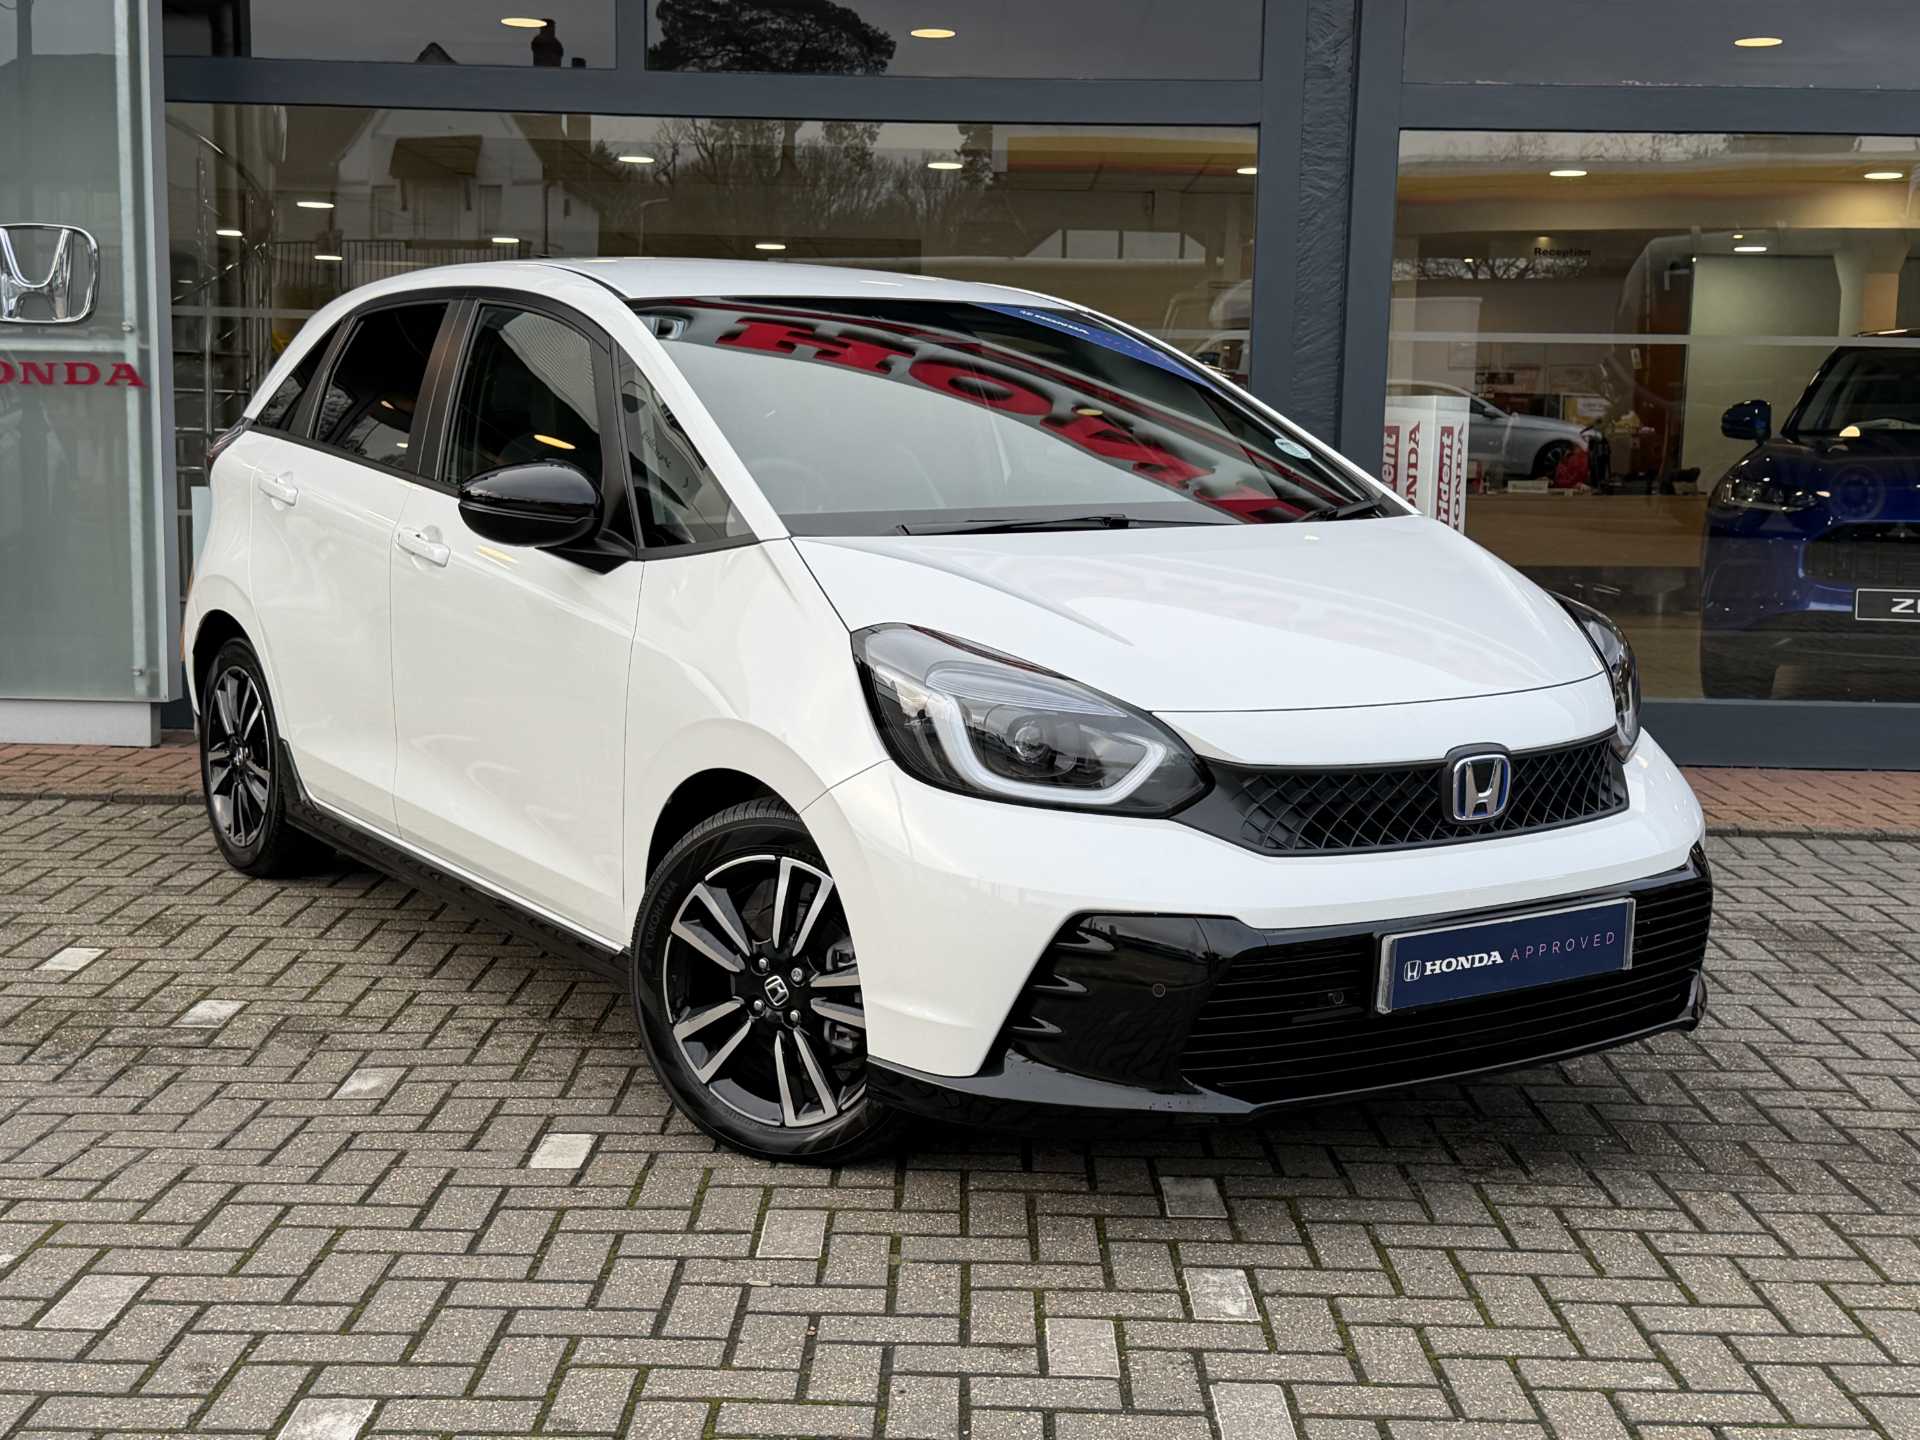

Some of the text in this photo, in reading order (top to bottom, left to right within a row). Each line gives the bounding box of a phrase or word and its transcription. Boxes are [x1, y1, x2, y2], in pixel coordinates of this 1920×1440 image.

[1533, 247, 1592, 258] Reception
[1890, 598, 1920, 614] Z
[1424, 931, 1615, 976] HONDA APPROVED
